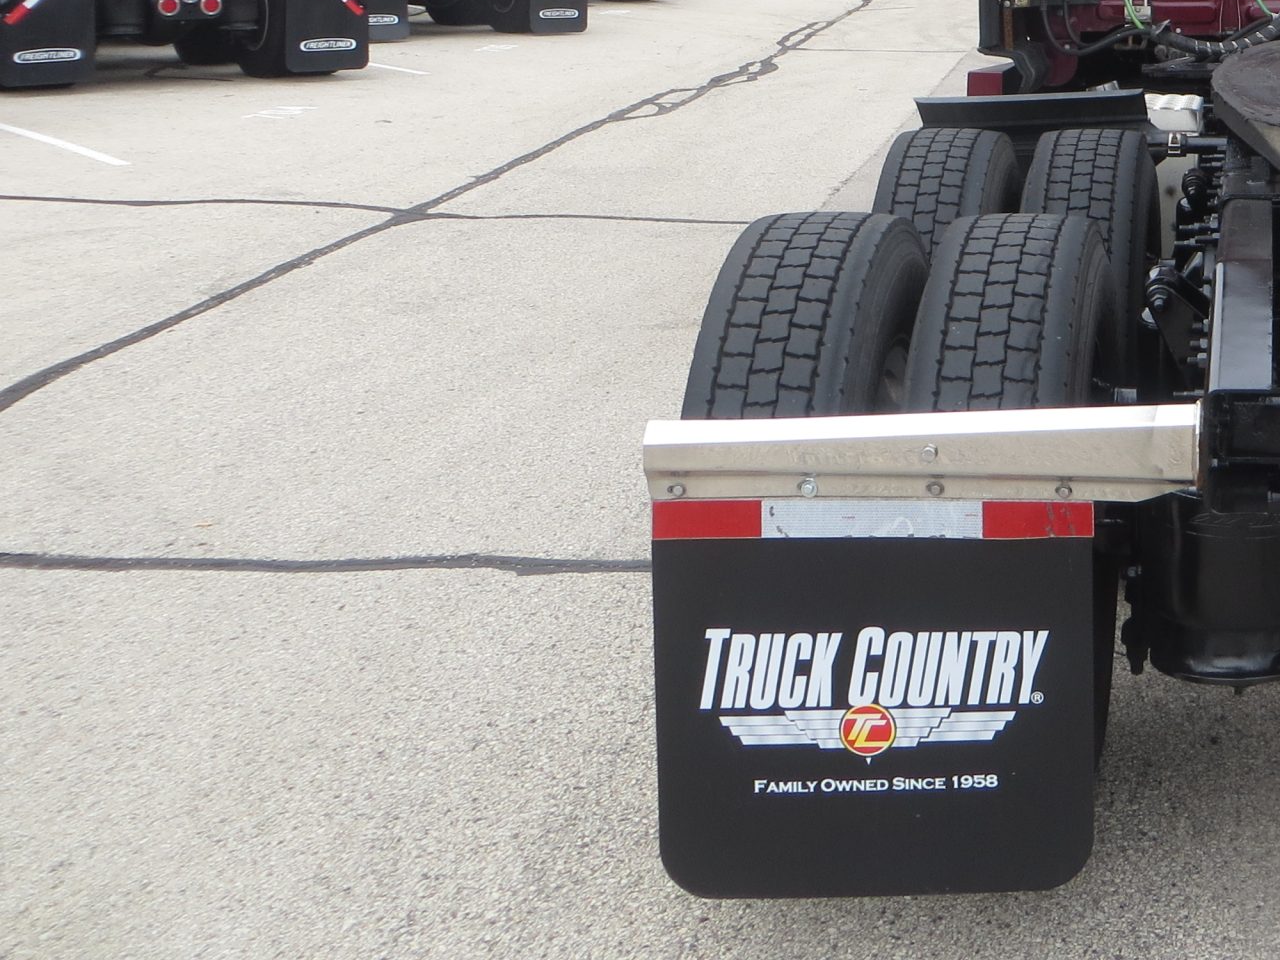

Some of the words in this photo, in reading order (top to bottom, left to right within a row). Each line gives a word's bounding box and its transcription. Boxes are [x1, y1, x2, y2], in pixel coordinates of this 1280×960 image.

[306, 40, 352, 50] FREIGHTLINER
[19, 51, 75, 61] FREIGHTLINER
[700, 628, 843, 710] TRUCK
[754, 780, 818, 794] FAMILY
[820, 778, 889, 792] OWNED
[892, 776, 946, 791] SINCE
[952, 775, 998, 789] 1958
